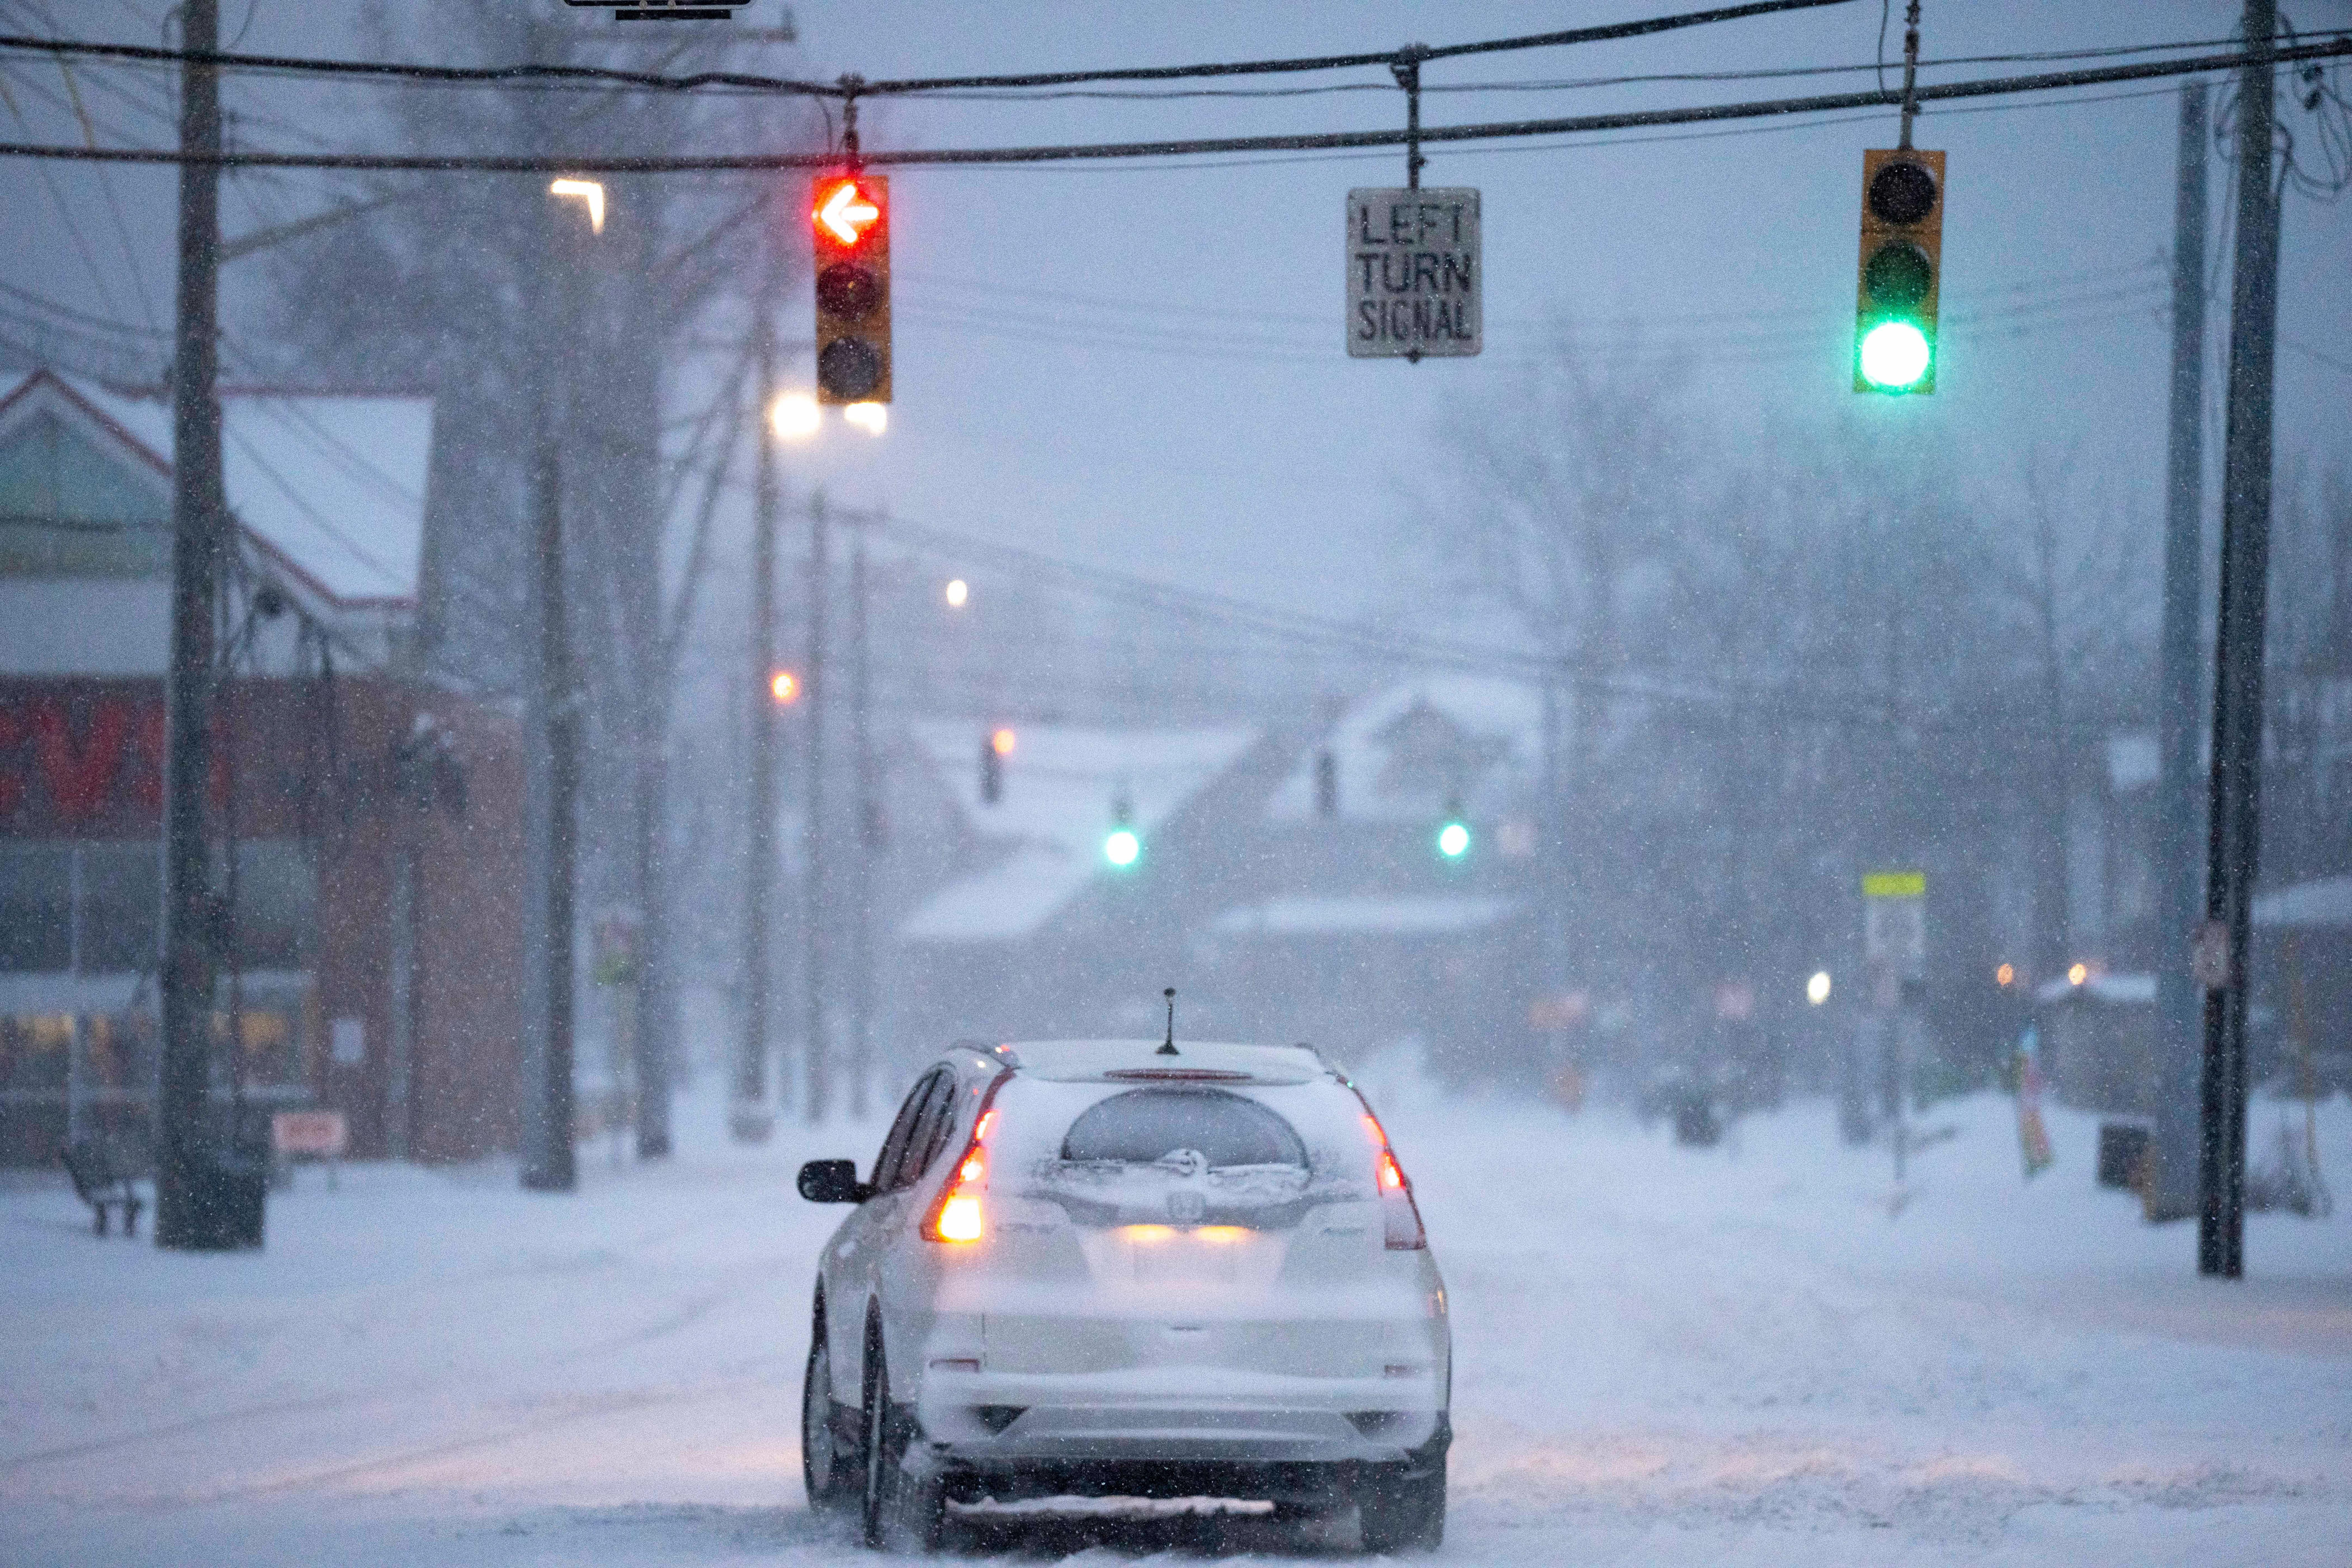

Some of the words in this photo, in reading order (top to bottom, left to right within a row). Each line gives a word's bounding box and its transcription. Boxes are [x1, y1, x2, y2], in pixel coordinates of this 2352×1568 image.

[1361, 204, 1466, 244] LEFT
[1356, 253, 1470, 293] TURN
[1359, 300, 1472, 341] SIGNAL
